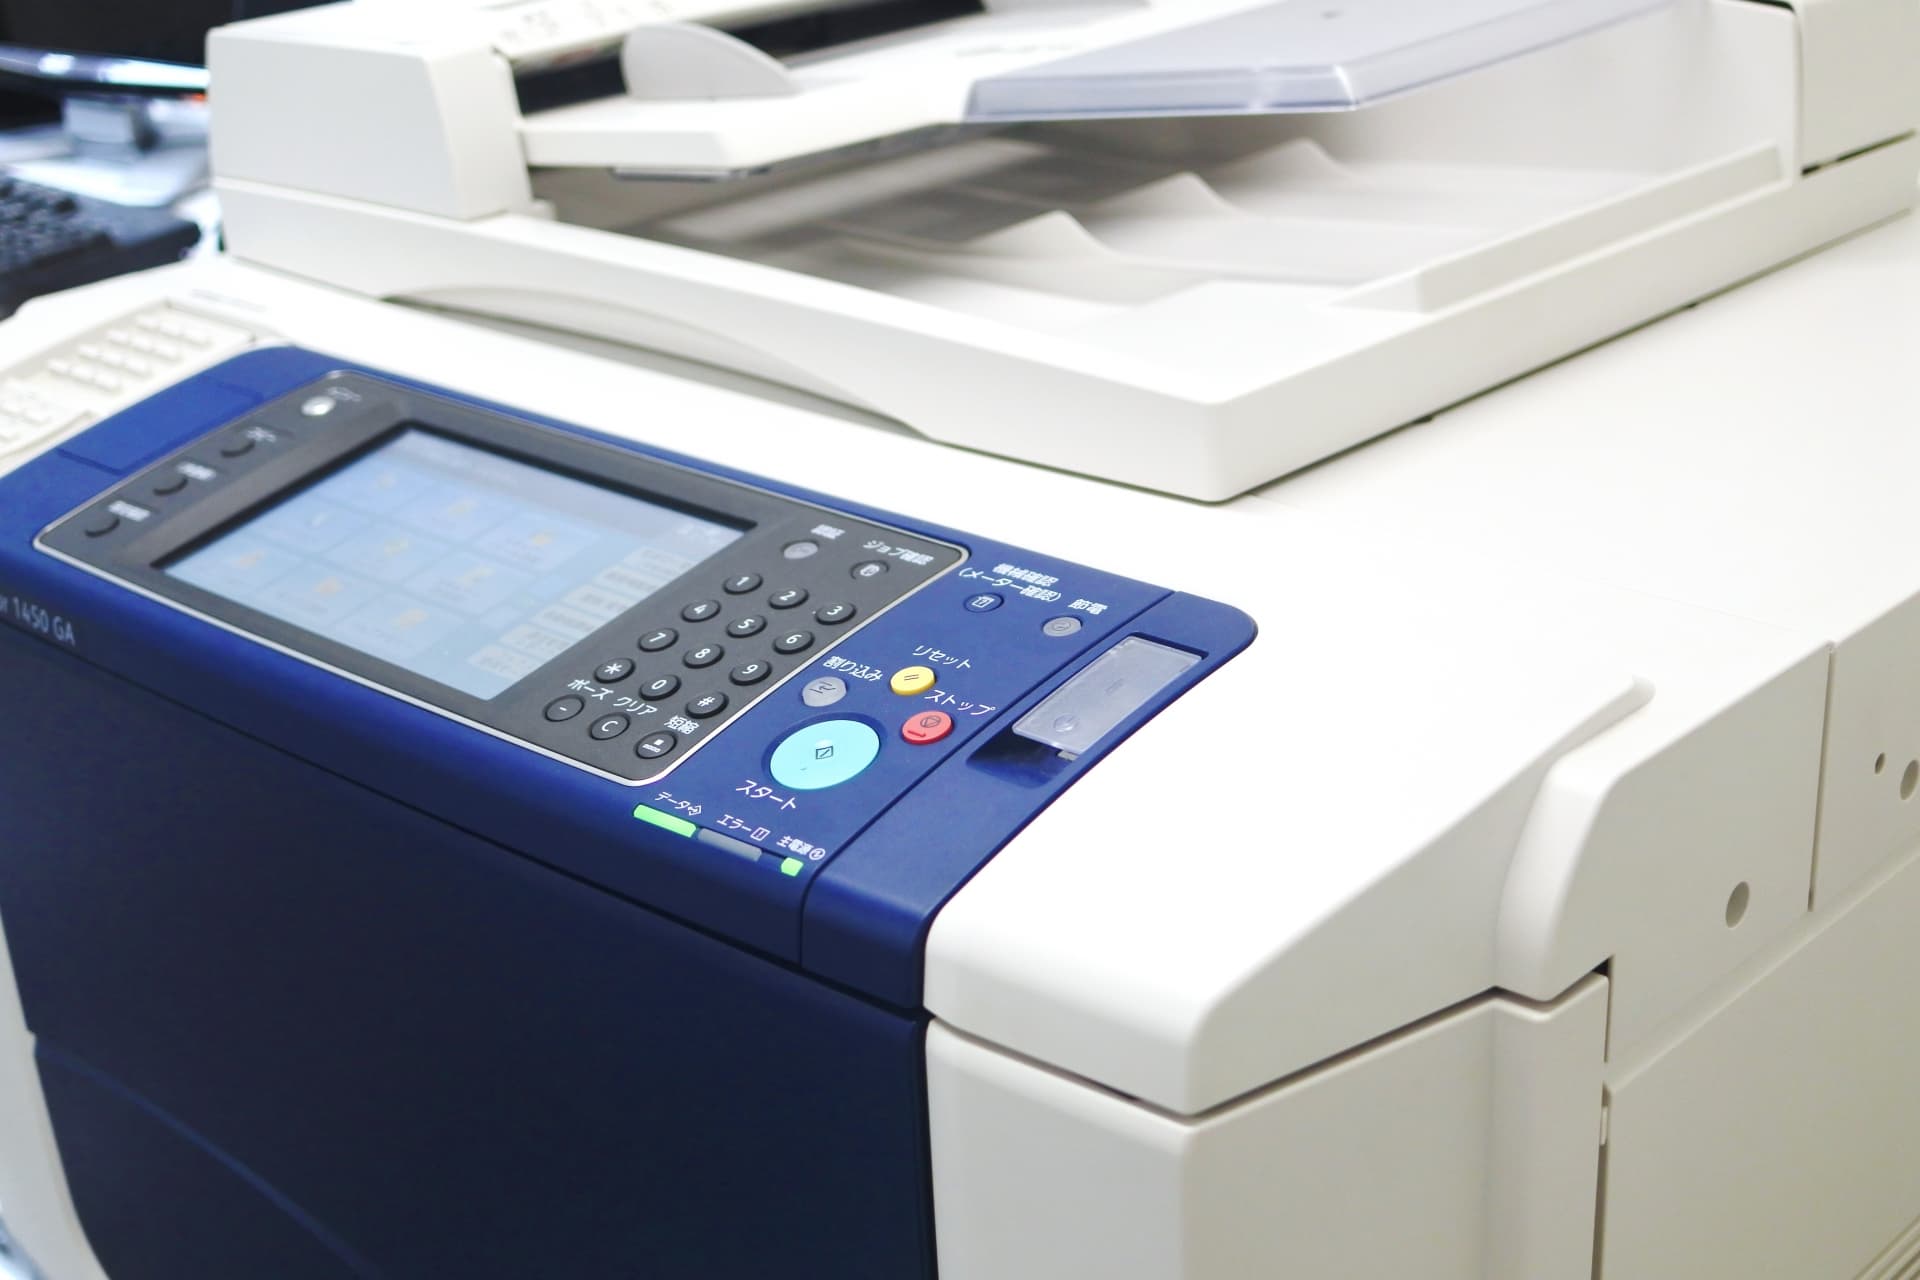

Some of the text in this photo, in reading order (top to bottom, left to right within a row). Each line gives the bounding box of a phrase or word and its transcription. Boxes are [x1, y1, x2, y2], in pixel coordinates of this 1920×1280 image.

[736, 576, 750, 586] 1
[779, 590, 797, 602] 2
[693, 603, 708, 614] 4
[826, 605, 843, 616] 3
[737, 618, 755, 629] 5
[52, 615, 76, 647] GA
[649, 632, 667, 643] 7
[785, 633, 803, 645] 6
[694, 648, 711, 659] 8
[912, 645, 972, 670] リセット
[741, 664, 759, 675] 9
[822, 655, 884, 682] 割り込み
[568, 678, 614, 700] ポーズ
[651, 679, 667, 690] 0
[613, 696, 657, 715] クリア
[924, 689, 997, 716] ストップ
[601, 720, 619, 732] C
[664, 715, 700, 735] 短縮
[655, 791, 691, 810] データ
[735, 779, 797, 811] スタート
[716, 814, 752, 833] エラー
